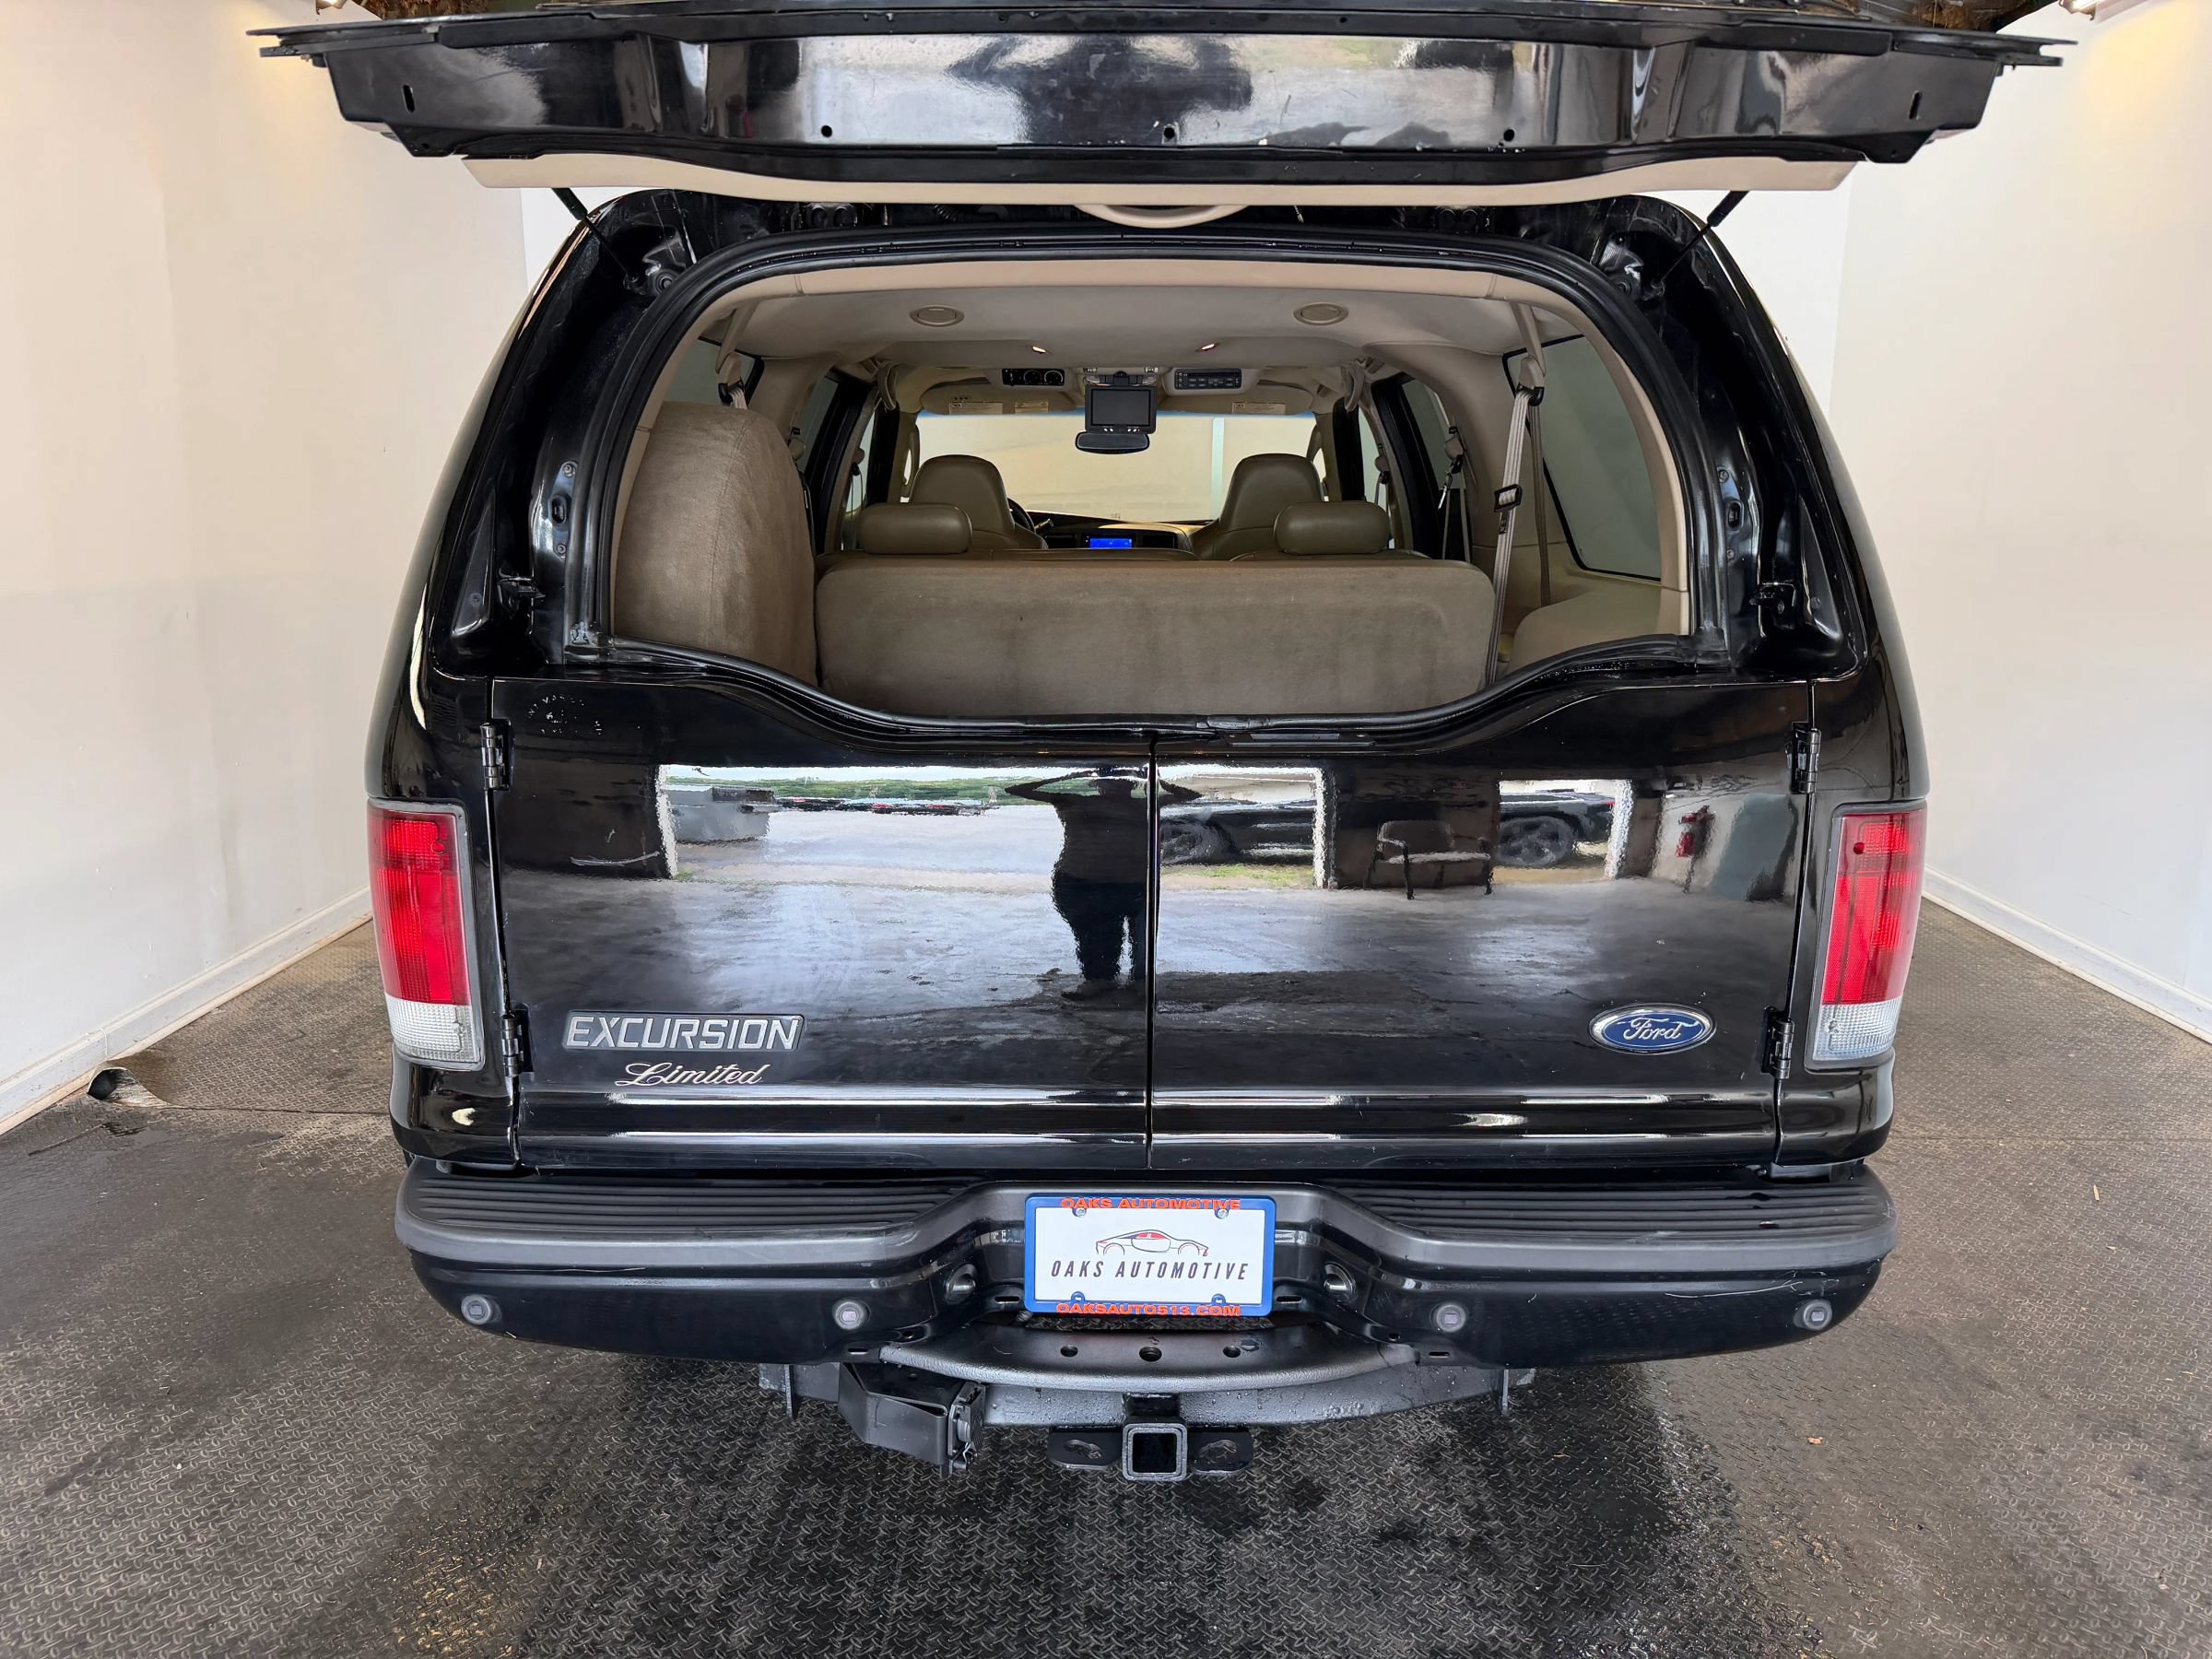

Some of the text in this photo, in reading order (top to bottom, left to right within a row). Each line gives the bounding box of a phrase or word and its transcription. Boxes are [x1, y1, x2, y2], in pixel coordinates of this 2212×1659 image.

[566, 1017, 798, 1049] EXCURSION
[1623, 1017, 1682, 1040] Ford
[614, 1062, 771, 1087] Limited
[1061, 1197, 1241, 1210] OAKS AUTOMOTIVE
[1051, 1260, 1248, 1279] OAKS AUTOMOTIVE
[1056, 1303, 1241, 1316] OAKSAUTO513.COM
